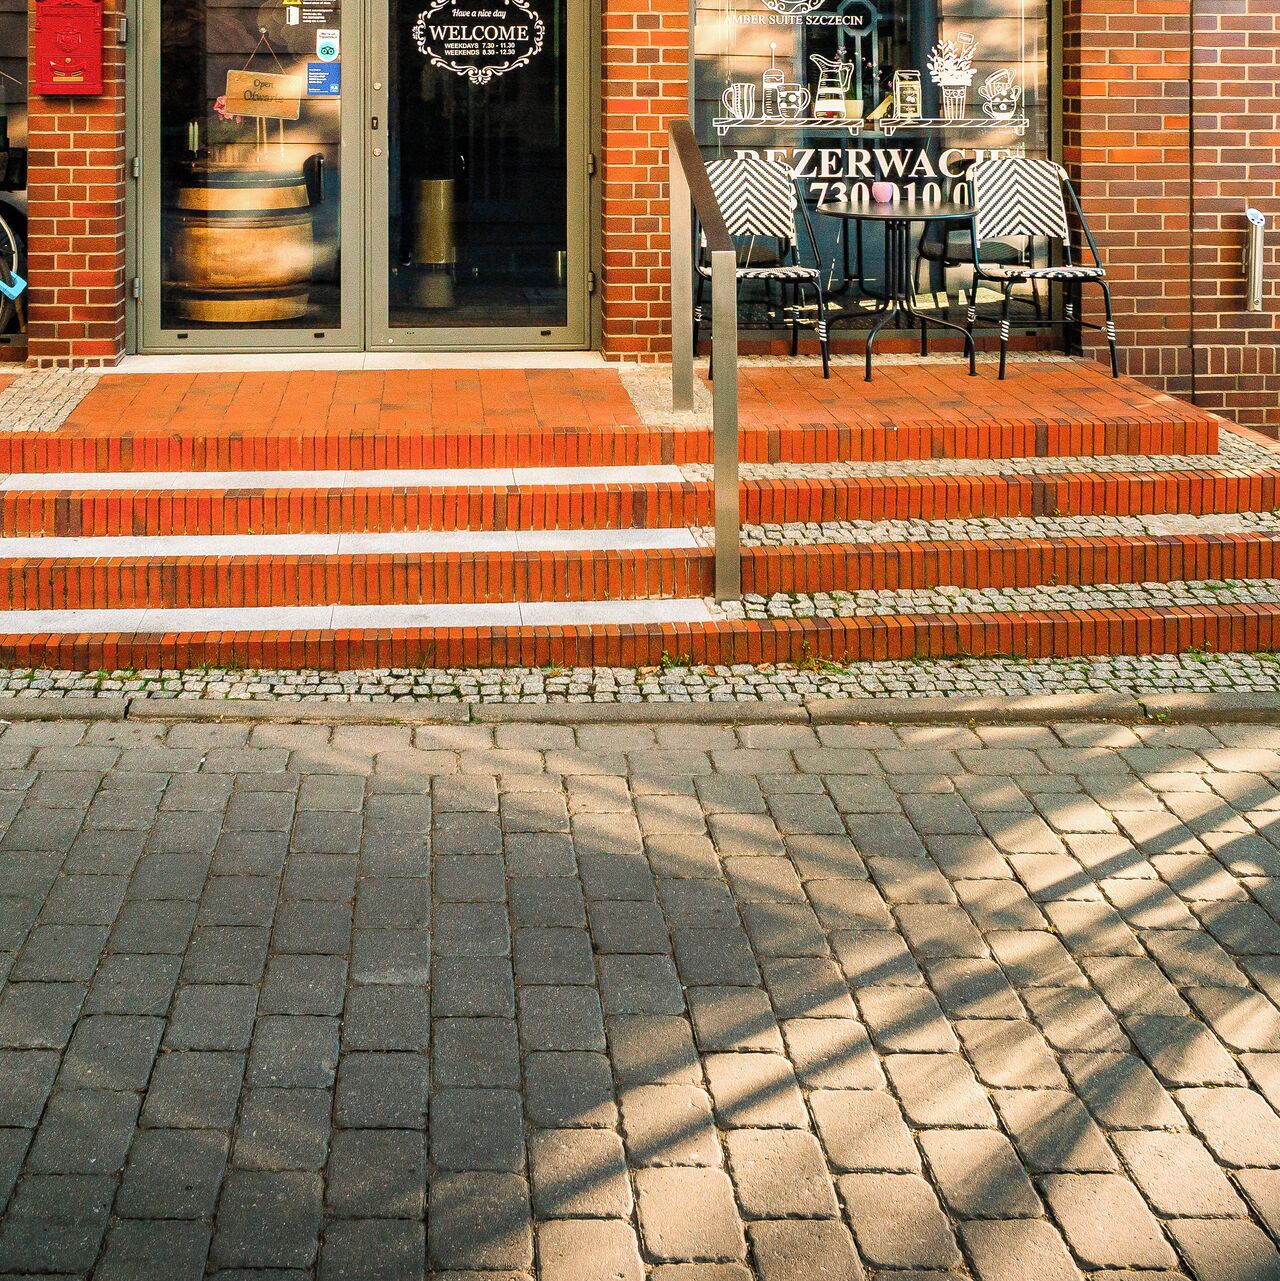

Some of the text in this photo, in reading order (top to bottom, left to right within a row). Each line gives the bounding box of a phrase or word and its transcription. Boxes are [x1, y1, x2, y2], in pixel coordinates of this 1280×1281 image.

[452, 9, 470, 17] Have
[477, 9, 492, 17] nice
[492, 9, 507, 19] day
[724, 14, 863, 26] AMBER SUITE SZCZECIN
[429, 25, 529, 41] WELCOME
